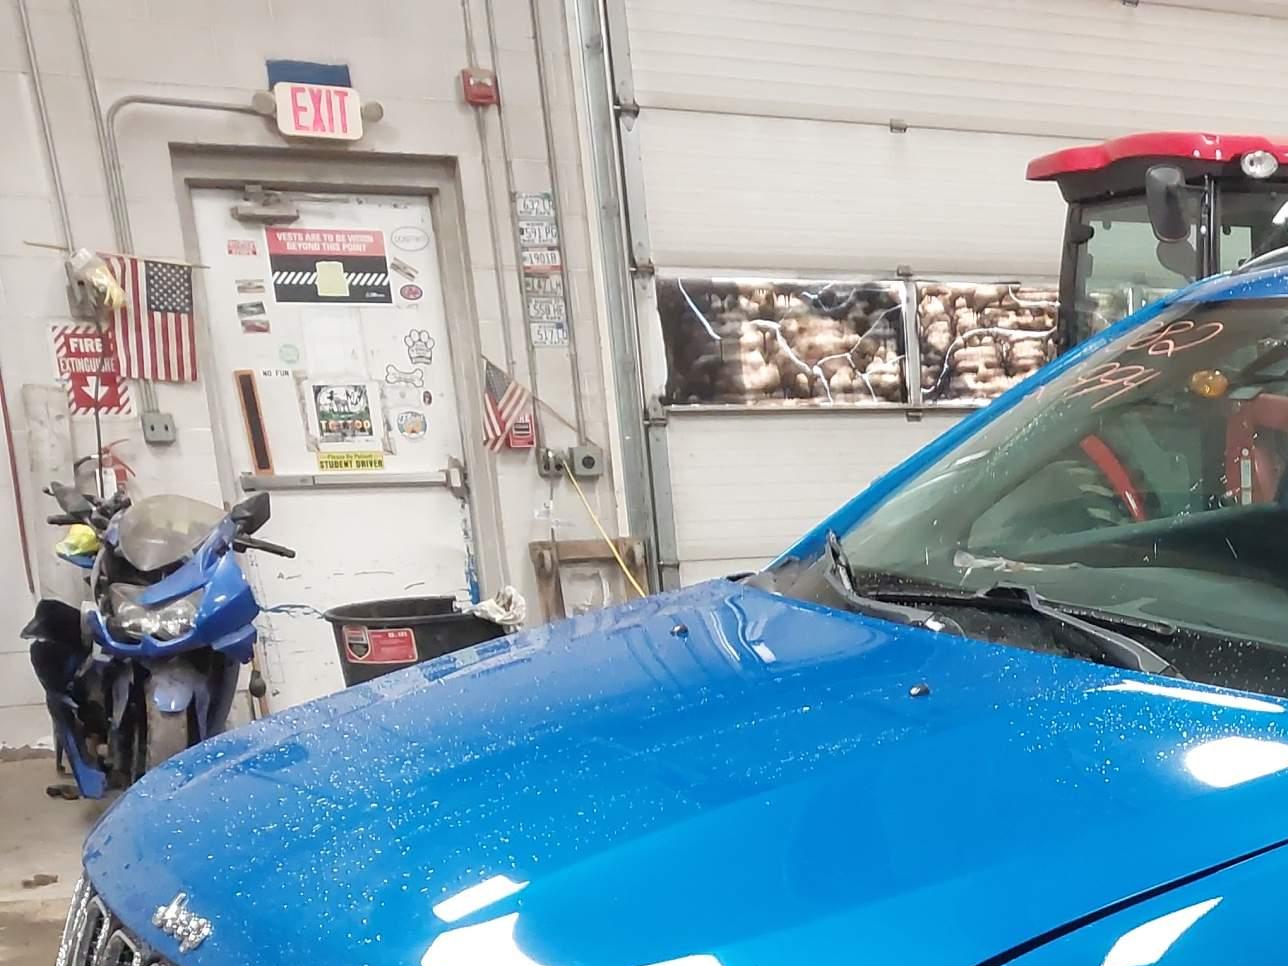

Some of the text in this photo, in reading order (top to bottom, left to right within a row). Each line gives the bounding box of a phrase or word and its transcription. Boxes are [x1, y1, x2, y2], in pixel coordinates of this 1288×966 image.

[290, 87, 349, 133] EXIT
[276, 232, 304, 242] VESTS
[305, 233, 322, 243] ARE
[323, 234, 335, 243] TO
[335, 234, 348, 243] BE
[286, 241, 367, 253] BEYOND THIS POINT
[69, 337, 103, 353] FIRE
[262, 369, 290, 377] NO FUN
[319, 459, 384, 469] STUDENT DRIVER
